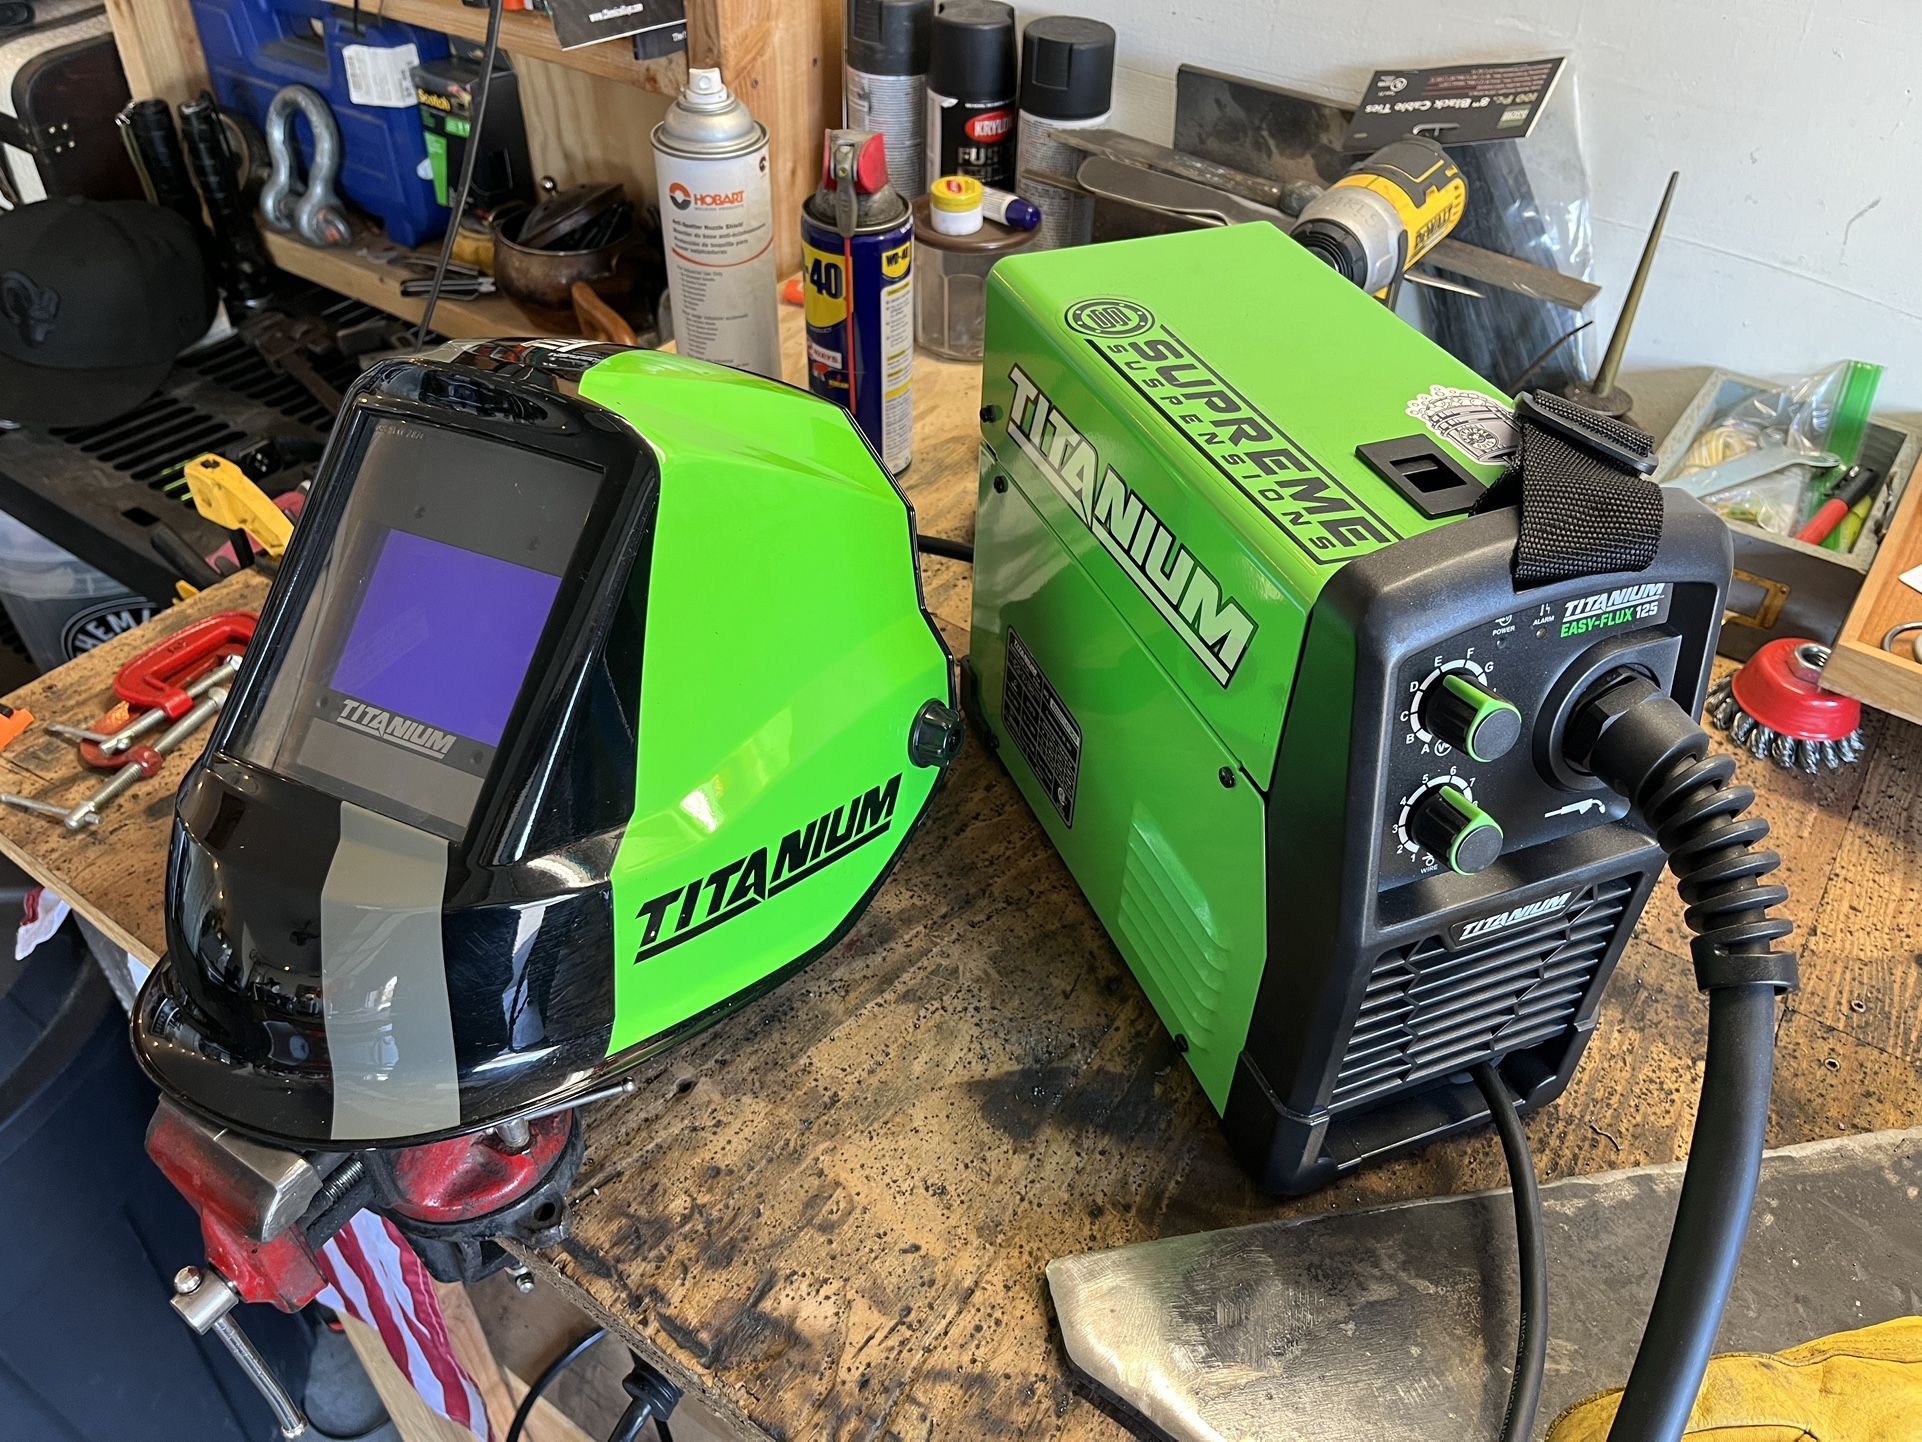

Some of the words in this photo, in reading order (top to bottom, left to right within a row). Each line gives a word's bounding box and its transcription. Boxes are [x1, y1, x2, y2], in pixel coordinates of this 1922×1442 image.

[1365, 103, 1392, 115] Ties
[1394, 99, 1432, 112] Cable
[1433, 98, 1471, 109] Black
[694, 191, 745, 206] HOBART
[1106, 343, 1337, 550] SUSPENSIONS
[1127, 338, 1393, 548] SUPREME
[1007, 362, 1259, 685] TITANIUM
[1563, 583, 1666, 621] TITANIUM
[1532, 615, 1555, 626] ALARM
[1560, 608, 1634, 639] EASY-FLUX
[1635, 602, 1659, 620] 125
[1492, 625, 1516, 637] POWER
[1466, 647, 1475, 659] F
[1434, 655, 1443, 667] E
[1484, 661, 1494, 673] G
[1409, 681, 1419, 693] D
[1400, 710, 1410, 722] C
[337, 698, 457, 758] TITANIUM
[1405, 733, 1415, 744] B
[1420, 743, 1431, 755] A
[1449, 765, 1457, 775] 6
[1421, 773, 1429, 784] 5
[1469, 777, 1476, 787] 7
[1399, 796, 1407, 806] 4
[1391, 824, 1399, 834] 3
[1396, 844, 1404, 855] 2
[1410, 853, 1417, 863] 1
[634, 771, 903, 958] TITANIUM
[1420, 863, 1439, 874] WIRE
[1458, 891, 1572, 941] TITANIUM
